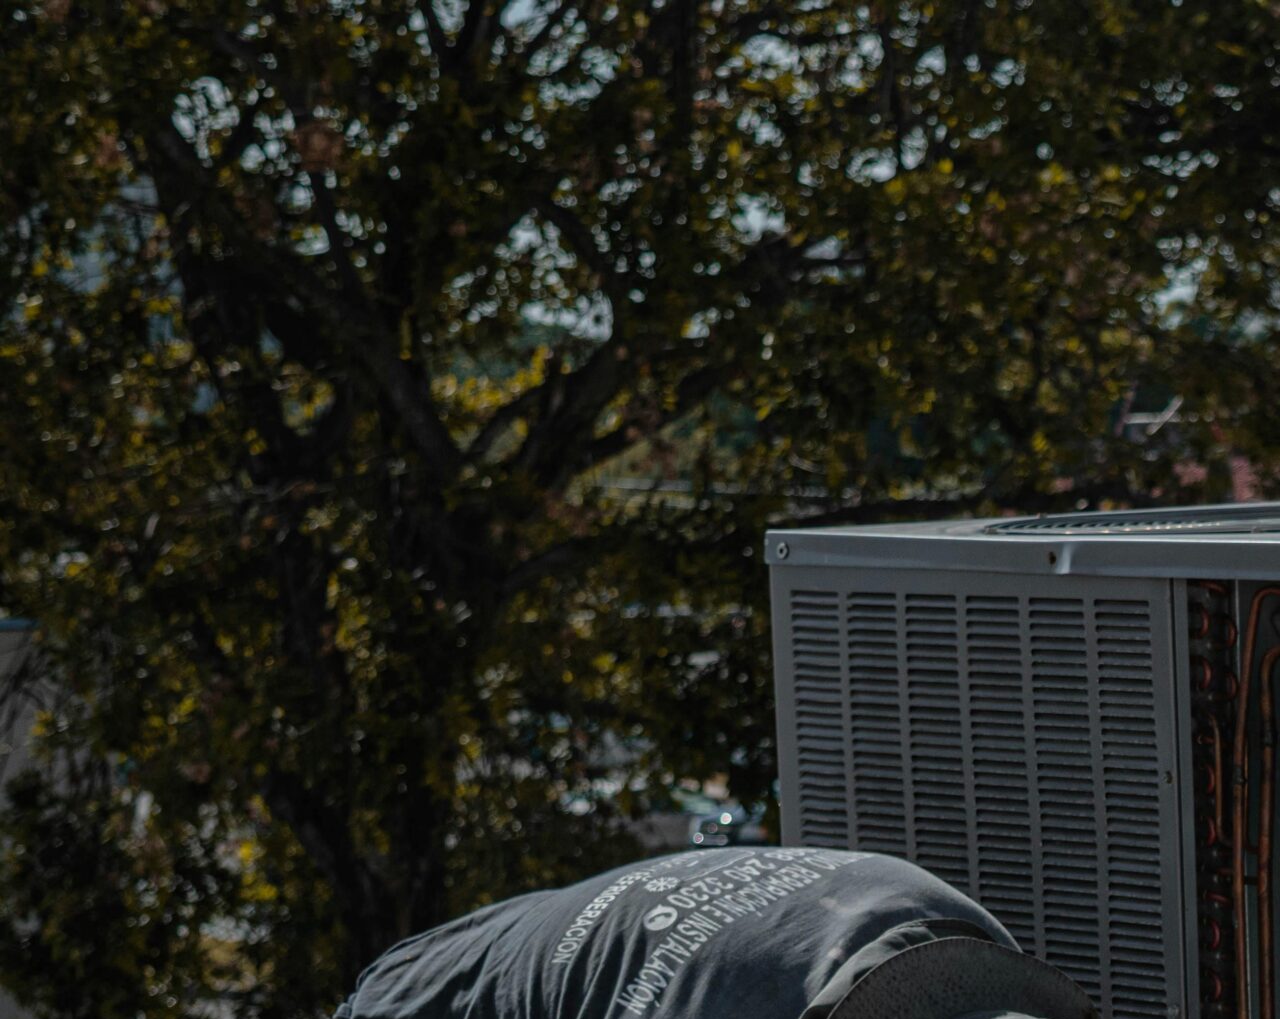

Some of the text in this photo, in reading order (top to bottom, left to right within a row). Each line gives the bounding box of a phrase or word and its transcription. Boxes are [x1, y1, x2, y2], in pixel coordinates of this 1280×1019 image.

[723, 857, 767, 881] 240
[667, 877, 735, 909] 3230
[727, 863, 821, 916] REPARACIÓN
[703, 903, 733, 924] E
[616, 911, 720, 1016] INSTALACIÓN
